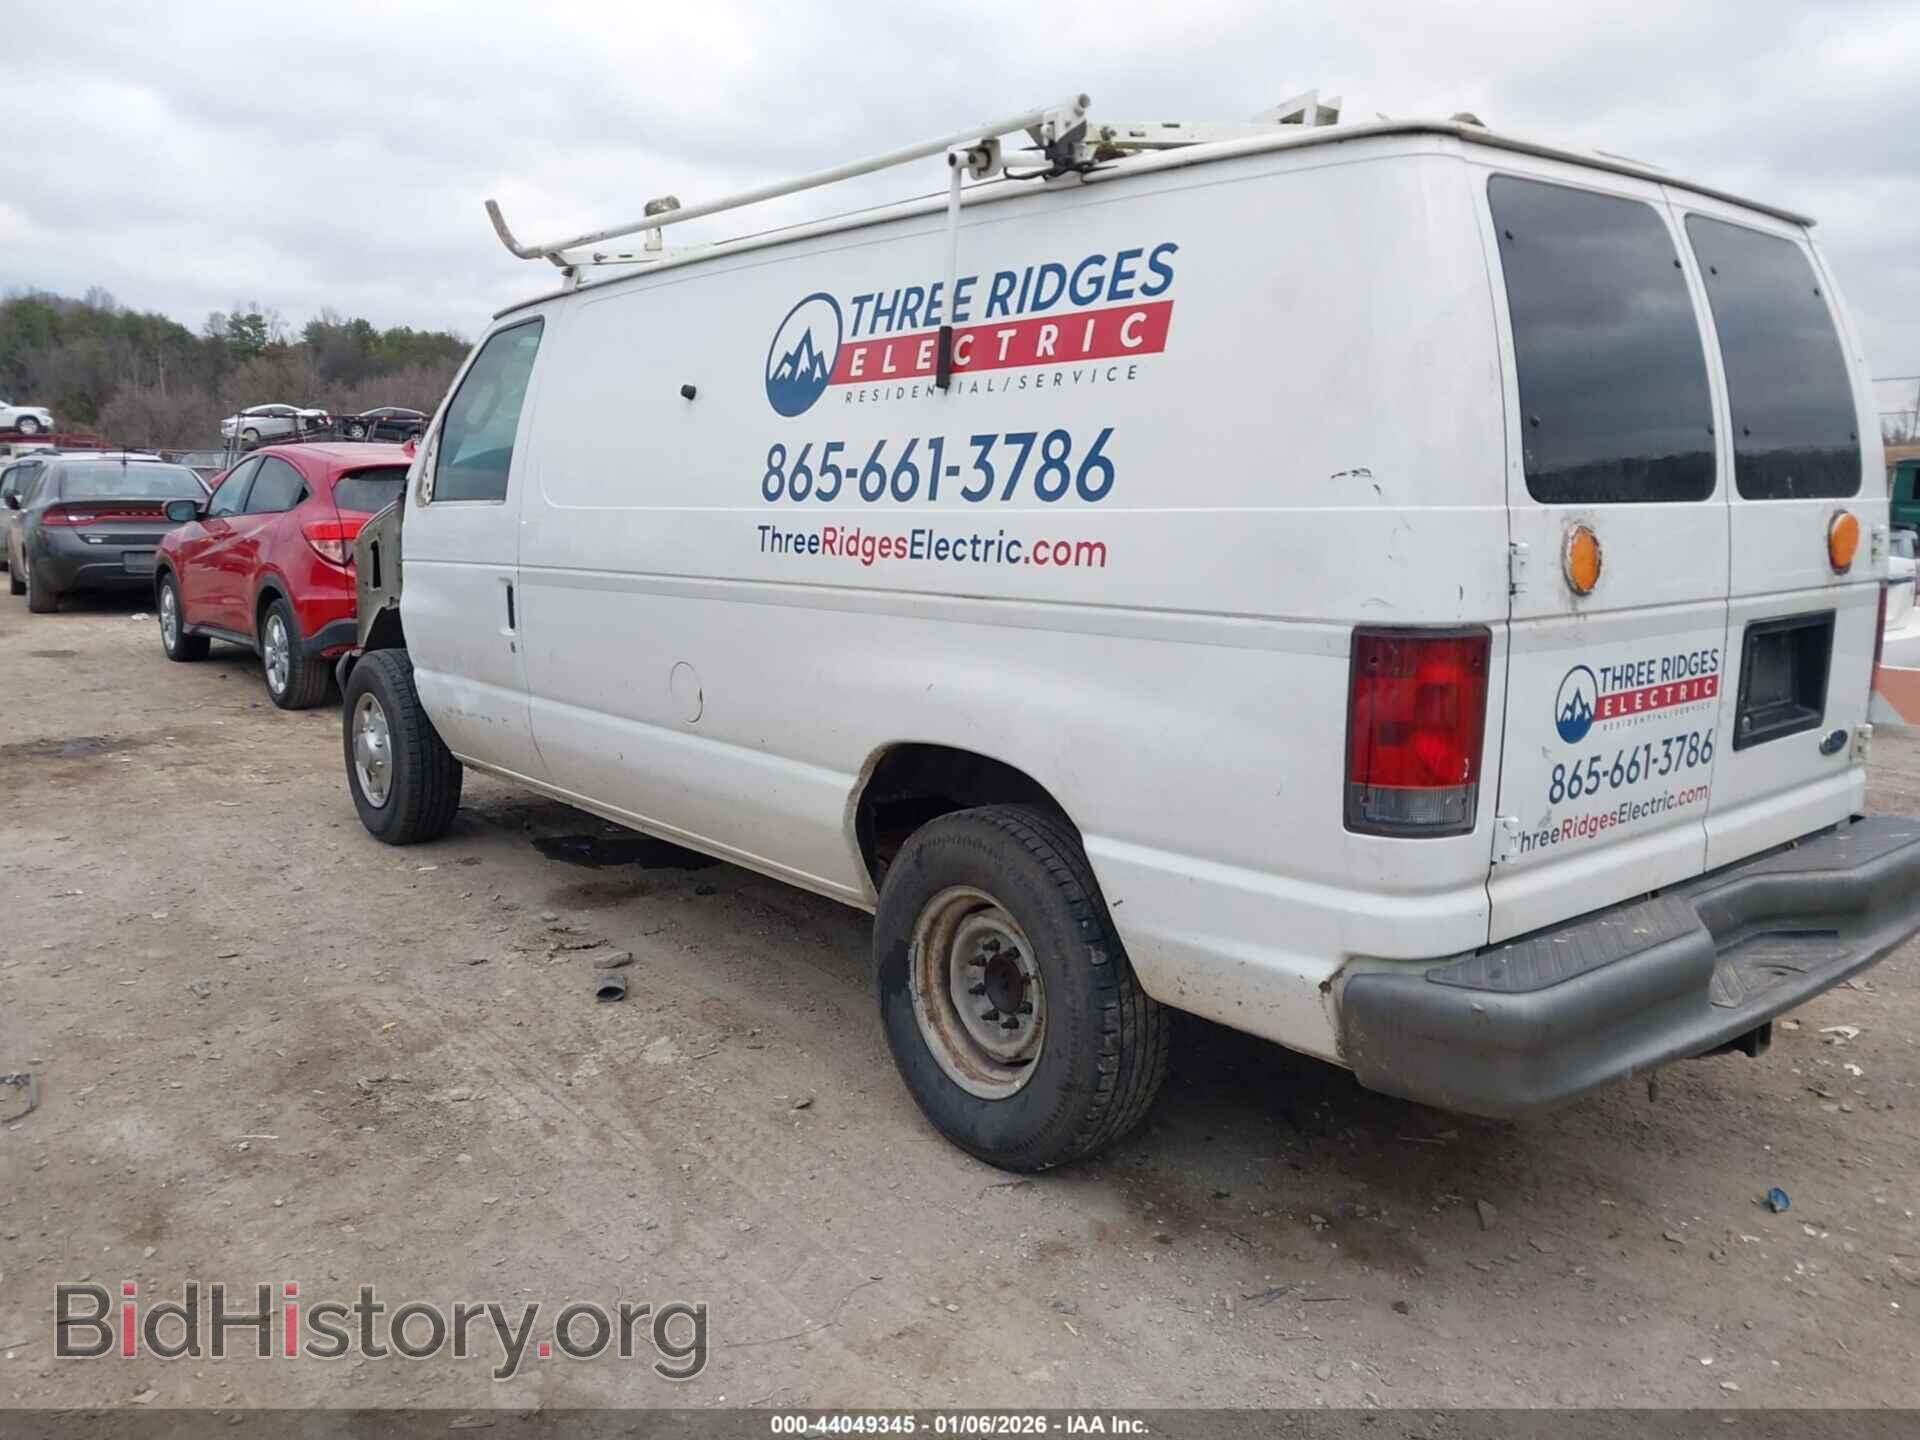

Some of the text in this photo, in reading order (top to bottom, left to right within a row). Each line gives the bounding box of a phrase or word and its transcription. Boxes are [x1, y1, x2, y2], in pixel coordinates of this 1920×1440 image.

[851, 242, 1179, 336] THREE RIDGES
[849, 312, 1147, 376] ELECTRIC
[762, 428, 1115, 502] 865-661-3786
[757, 525, 1107, 568] ThreeRidgesElectric.com
[1600, 648, 1719, 693] THREE RIDGES
[1604, 678, 1713, 716] ELECTRIC
[1549, 728, 1713, 804] 865-661-3786
[1517, 785, 1708, 854] hreeRidgesElectric.com
